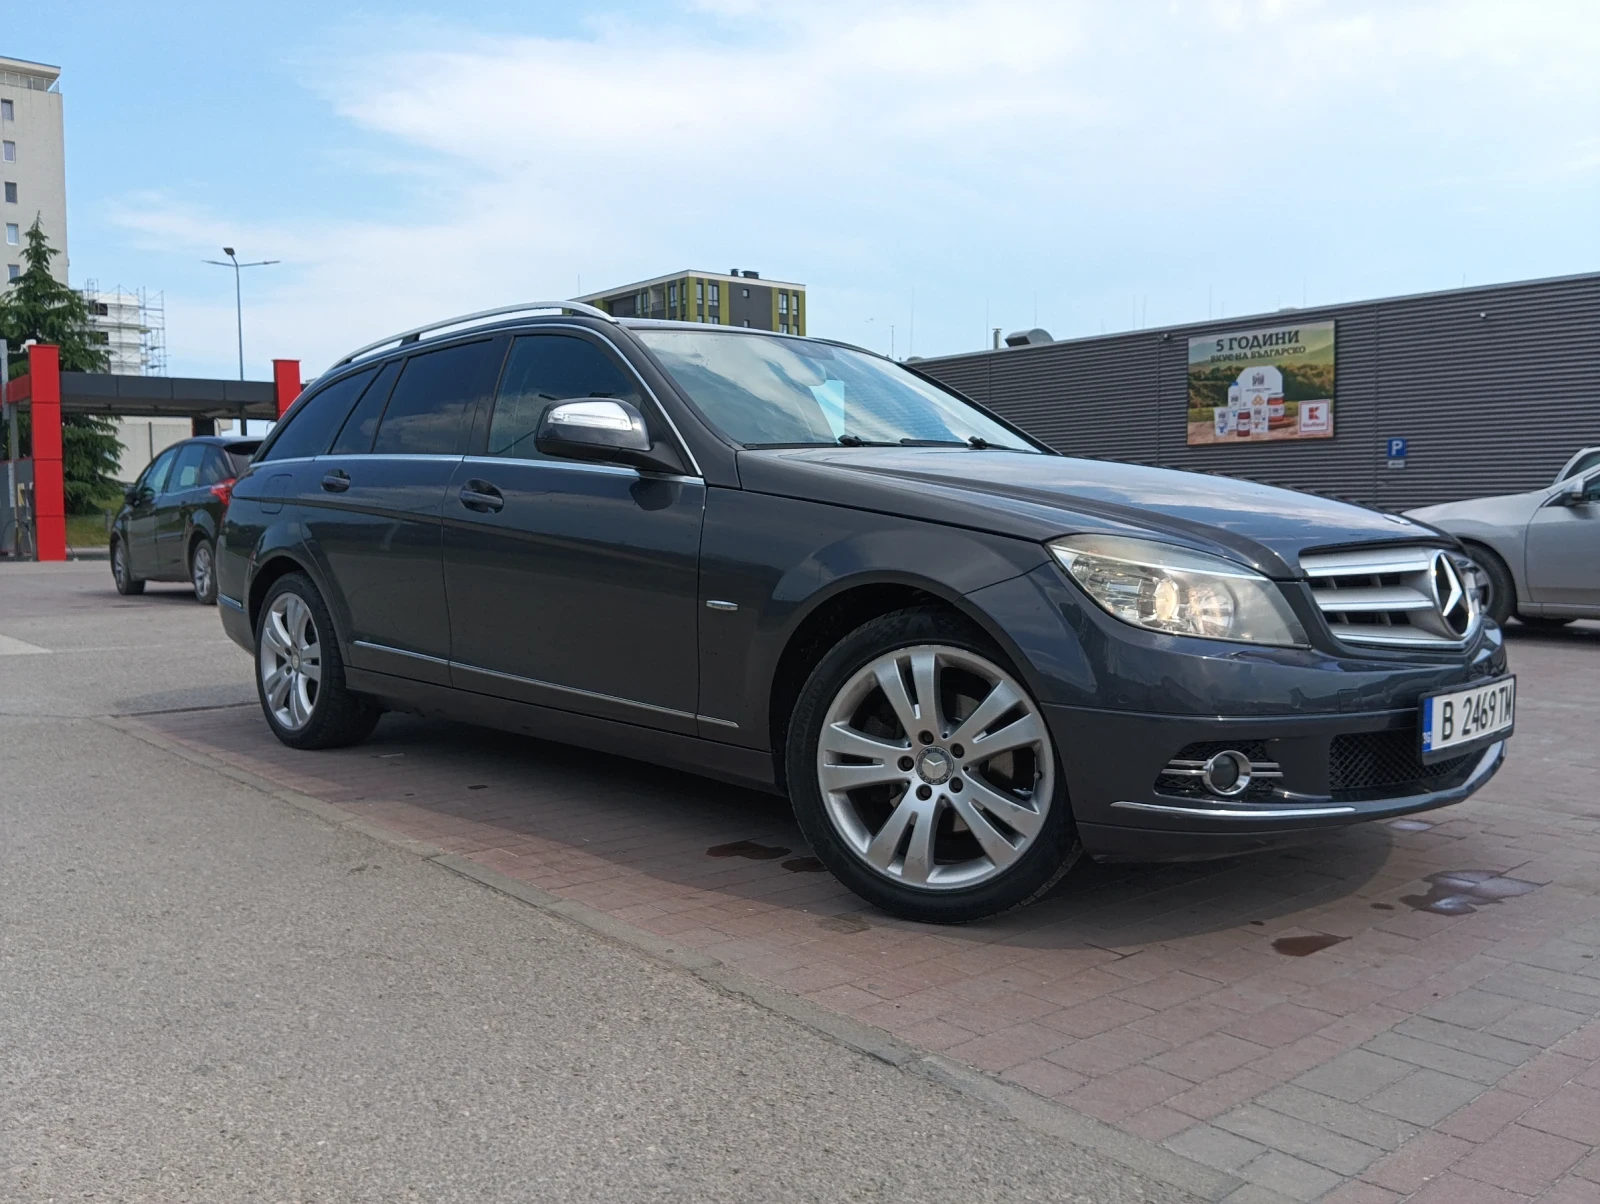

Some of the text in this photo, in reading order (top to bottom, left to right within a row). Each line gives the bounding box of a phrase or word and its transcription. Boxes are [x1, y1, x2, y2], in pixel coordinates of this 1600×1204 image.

[1216, 330, 1300, 352] 5 ГОДИНИ
[1235, 352, 1249, 361] НА
[1251, 345, 1307, 360] БЪЛГАРСКО
[1391, 440, 1403, 456] P
[1442, 700, 1454, 741] B
[1461, 690, 1497, 736] 2469
